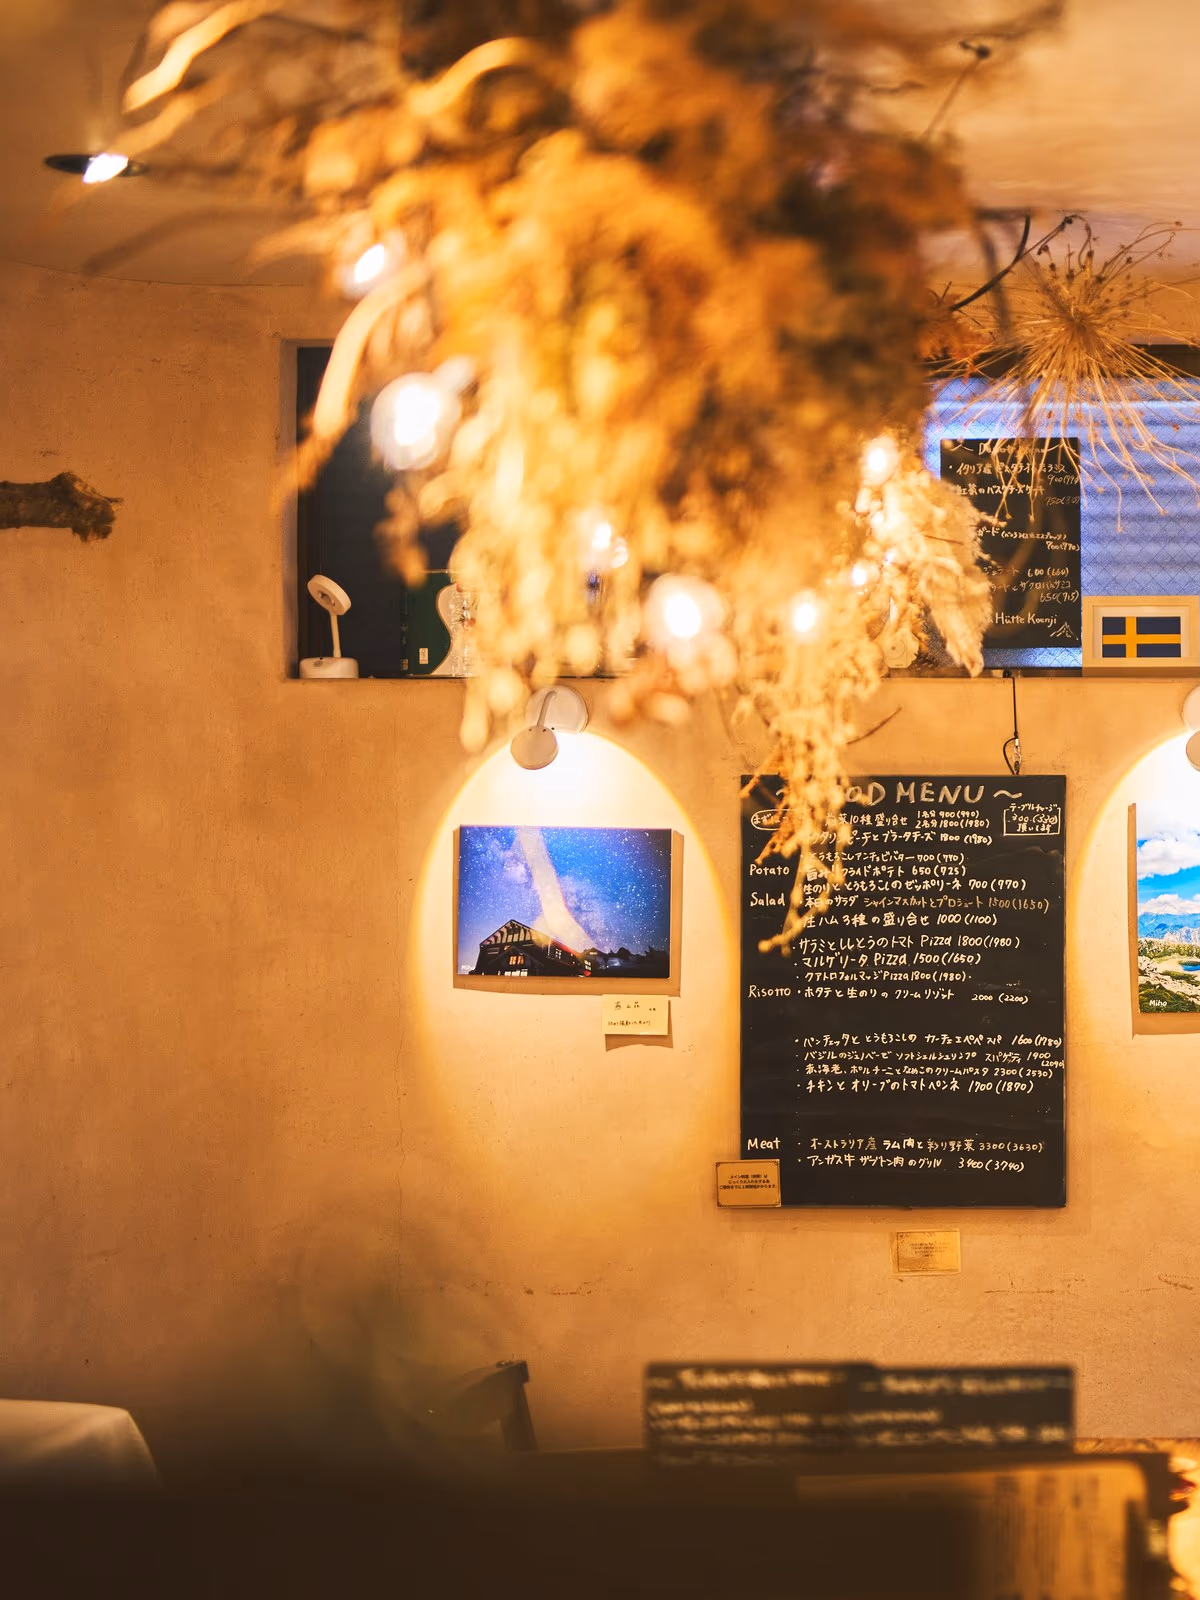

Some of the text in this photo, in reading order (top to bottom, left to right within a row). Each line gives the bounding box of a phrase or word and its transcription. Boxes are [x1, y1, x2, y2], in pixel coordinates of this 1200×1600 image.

[995, 612, 1025, 625] Hütte
[1027, 612, 1057, 628] Koenji
[895, 781, 985, 805] MENU
[749, 864, 790, 876] Potato
[750, 891, 786, 907] Salad
[920, 935, 952, 947] Pizza
[802, 951, 868, 969] マルゲリータ
[873, 952, 907, 966] Pizza
[748, 984, 792, 998] Risotto
[1149, 999, 1168, 1007] Miho
[747, 1136, 781, 1150] Meat
